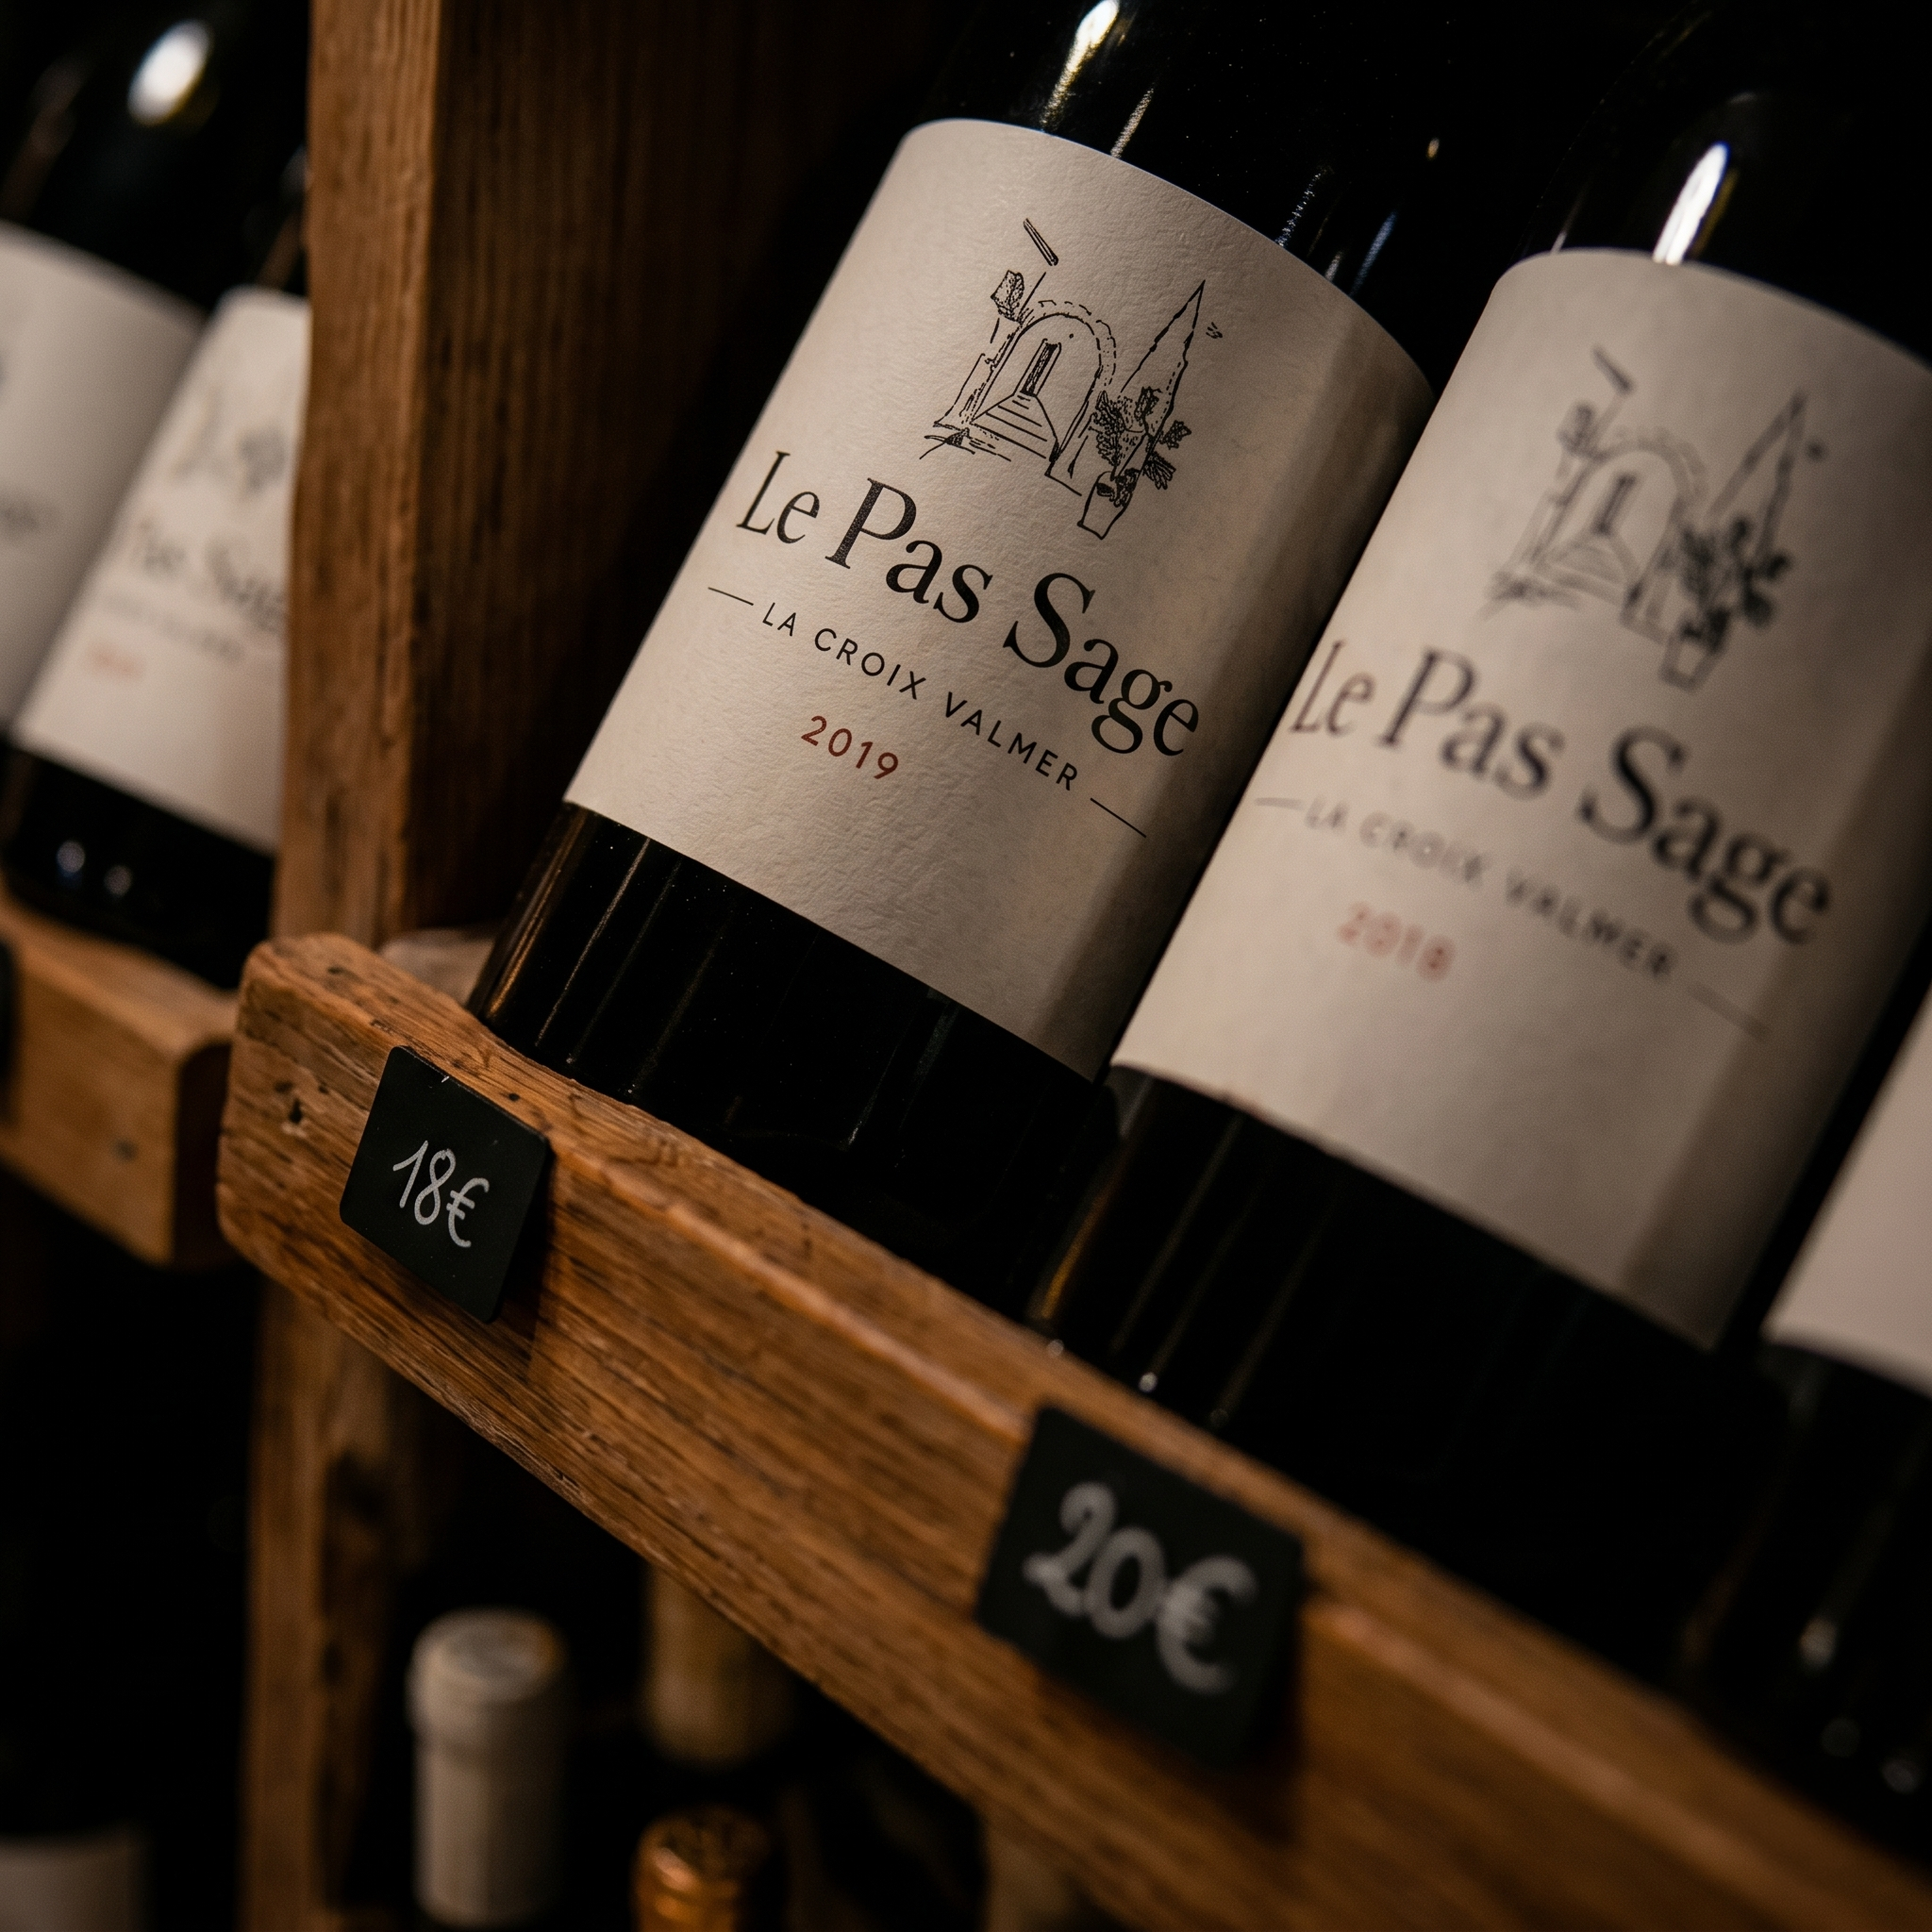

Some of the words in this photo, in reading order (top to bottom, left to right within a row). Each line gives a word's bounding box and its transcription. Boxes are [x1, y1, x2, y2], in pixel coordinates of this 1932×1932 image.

[736, 451, 821, 544] Le
[824, 477, 993, 624] Pas
[1003, 572, 1199, 757] Sage
[762, 602, 797, 637] LA
[813, 627, 926, 699] CROIX
[943, 691, 1078, 791] VALMER
[800, 715, 899, 780] 2019
[1289, 639, 1376, 737] Le
[1374, 645, 1566, 801] Pas
[1575, 724, 1831, 944] Sage
[1304, 797, 1349, 831] LA
[1359, 811, 1487, 888] CROIX
[1506, 870, 1675, 985] VALMER
[392, 1141, 490, 1248] 18€
[1022, 1480, 1257, 1695] 20€
